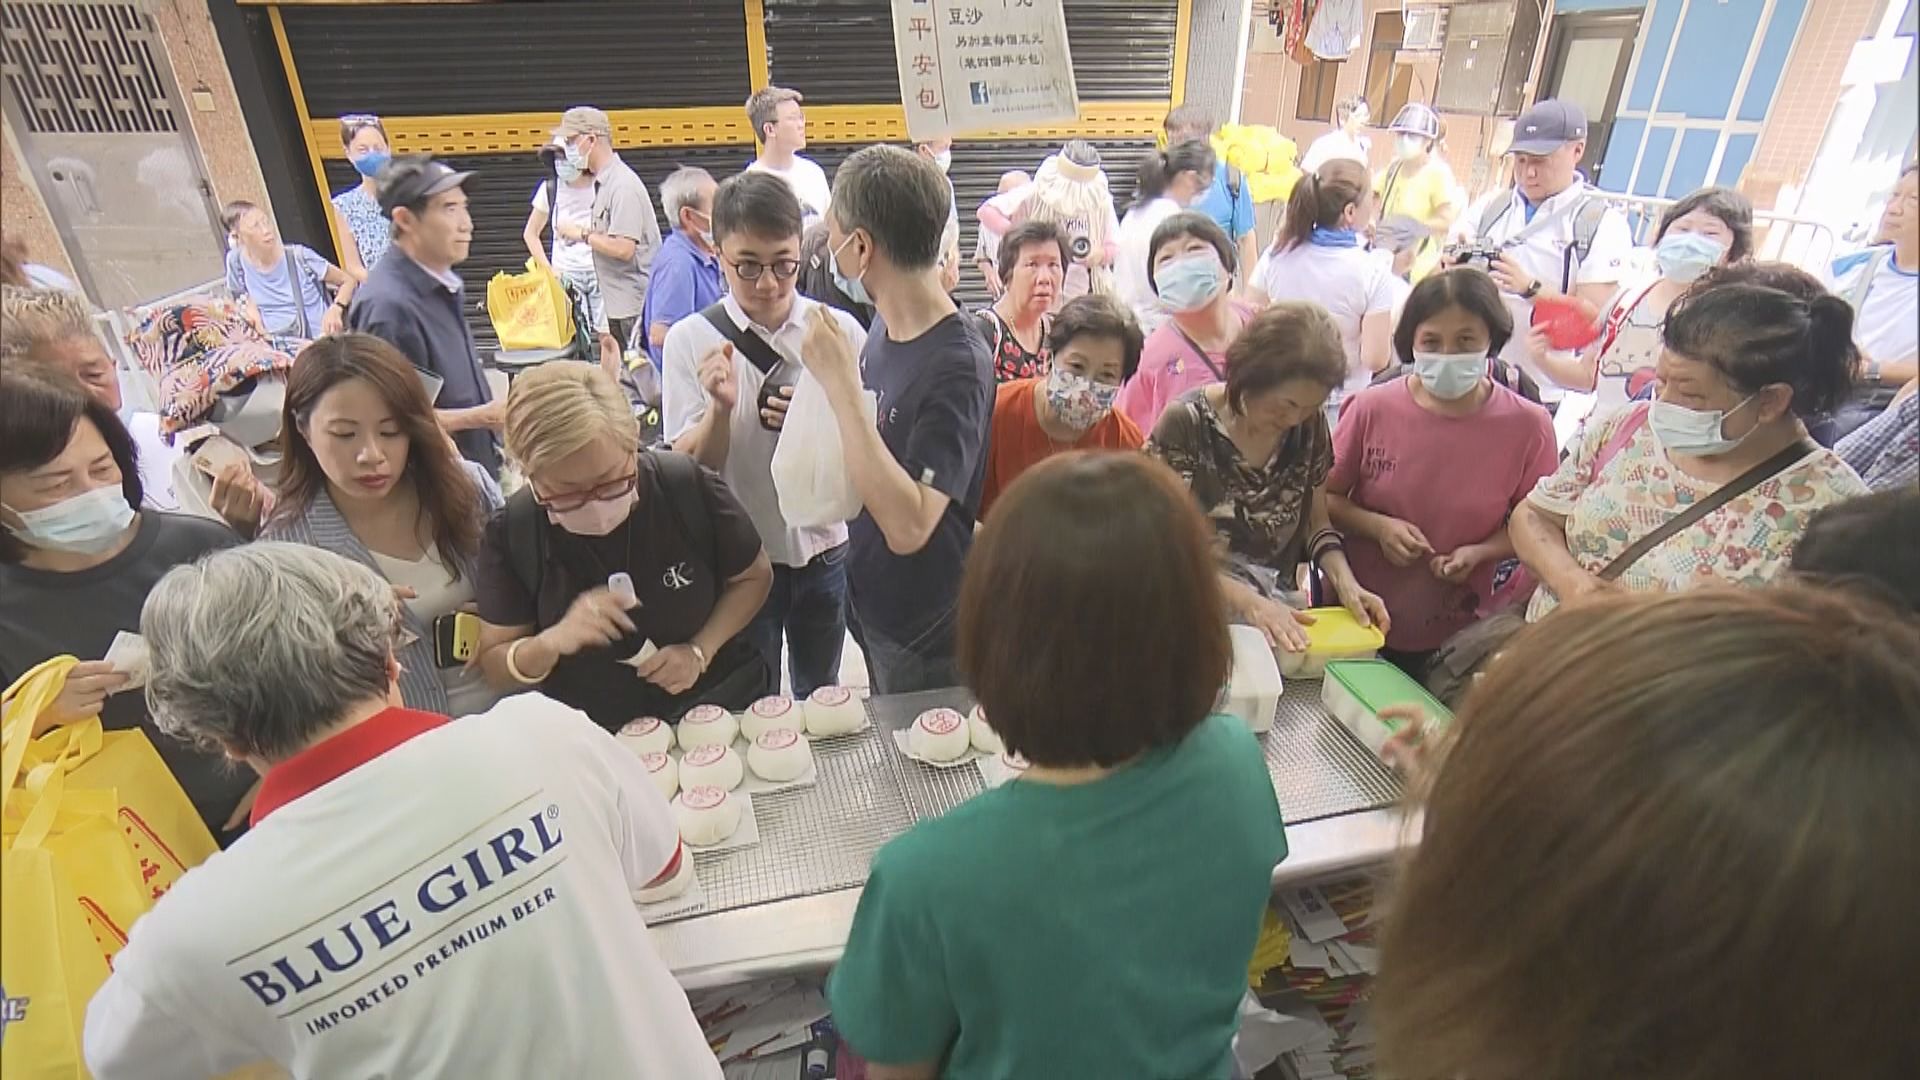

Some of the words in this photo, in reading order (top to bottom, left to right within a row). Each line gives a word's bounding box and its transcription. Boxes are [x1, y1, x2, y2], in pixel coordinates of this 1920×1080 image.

[909, 0, 940, 110] 平安包
[949, 8, 984, 26] 豆沙
[240, 900, 411, 1007] BLUE
[305, 972, 409, 1036] IMPORTED
[413, 915, 507, 979] PREMIUM
[511, 887, 556, 921] BEER
